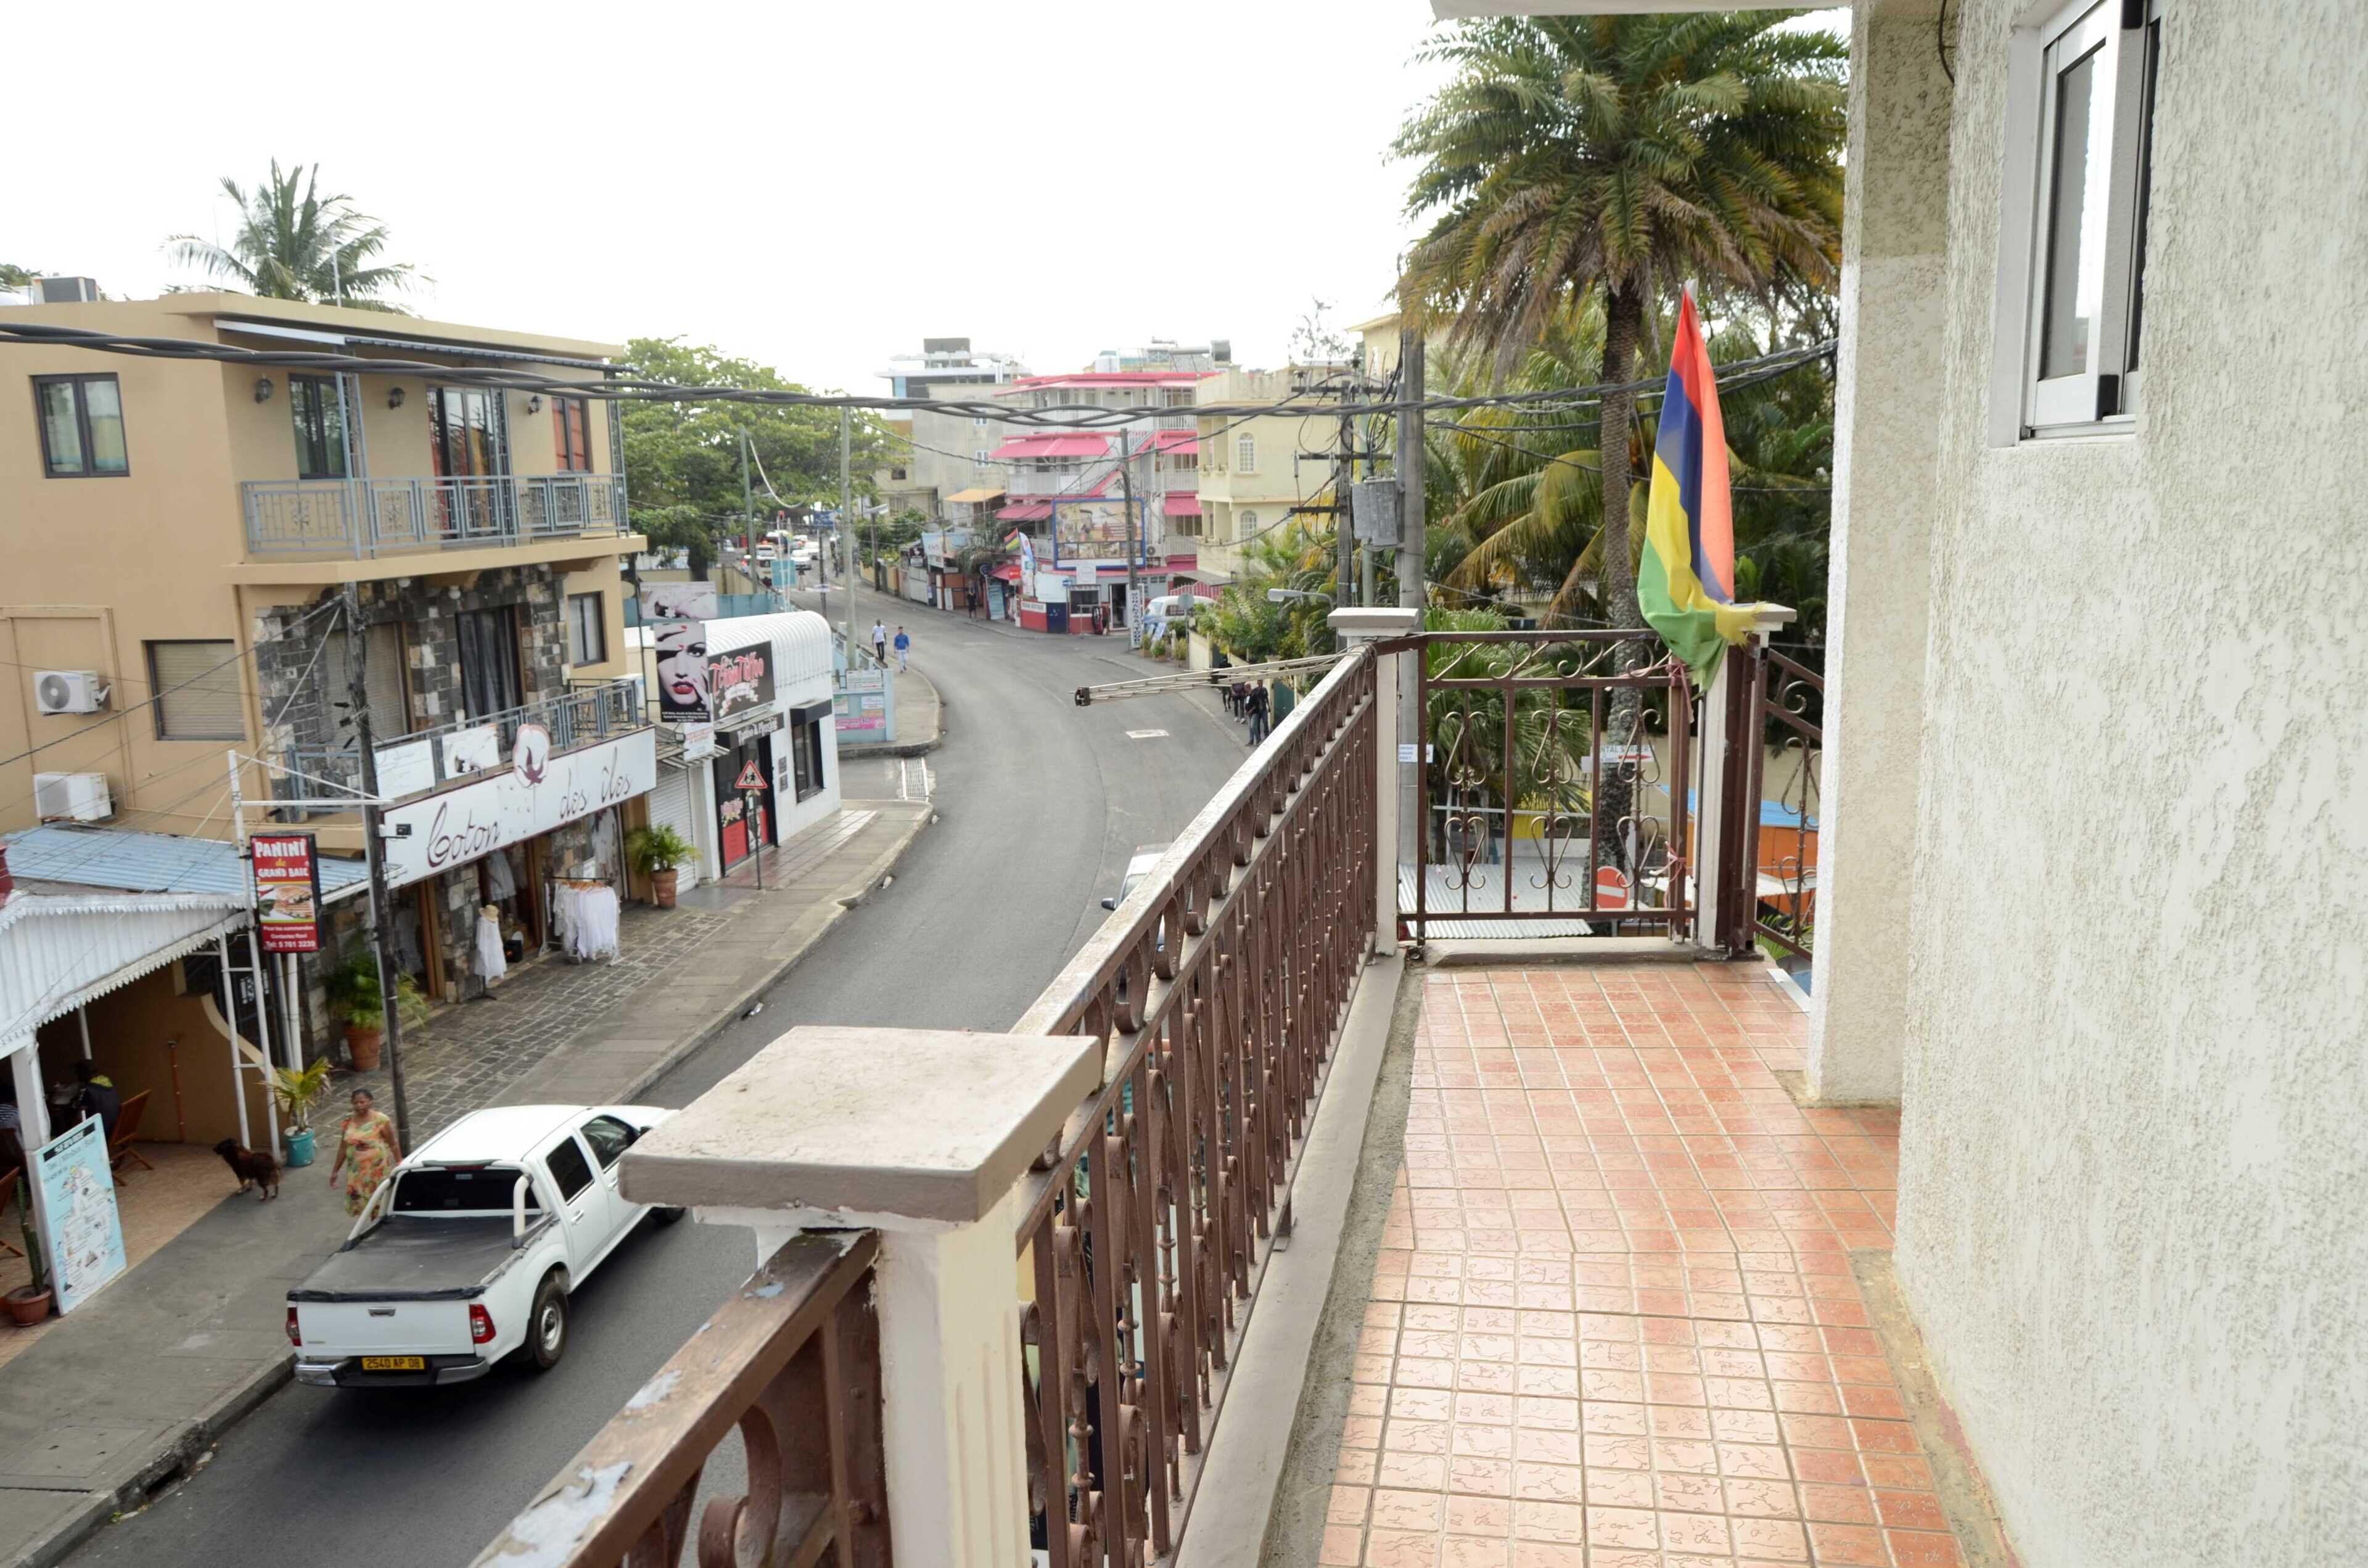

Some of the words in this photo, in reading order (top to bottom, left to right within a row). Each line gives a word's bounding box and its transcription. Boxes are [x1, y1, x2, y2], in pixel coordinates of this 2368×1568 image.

[427, 801, 500, 868] Coton
[560, 767, 589, 819] des
[601, 746, 635, 803] îles
[255, 839, 306, 858] PANINI
[258, 868, 287, 878] GRAND
[366, 1358, 390, 1368] 2540
[394, 1358, 405, 1368] AP
[409, 1358, 420, 1368] 08
